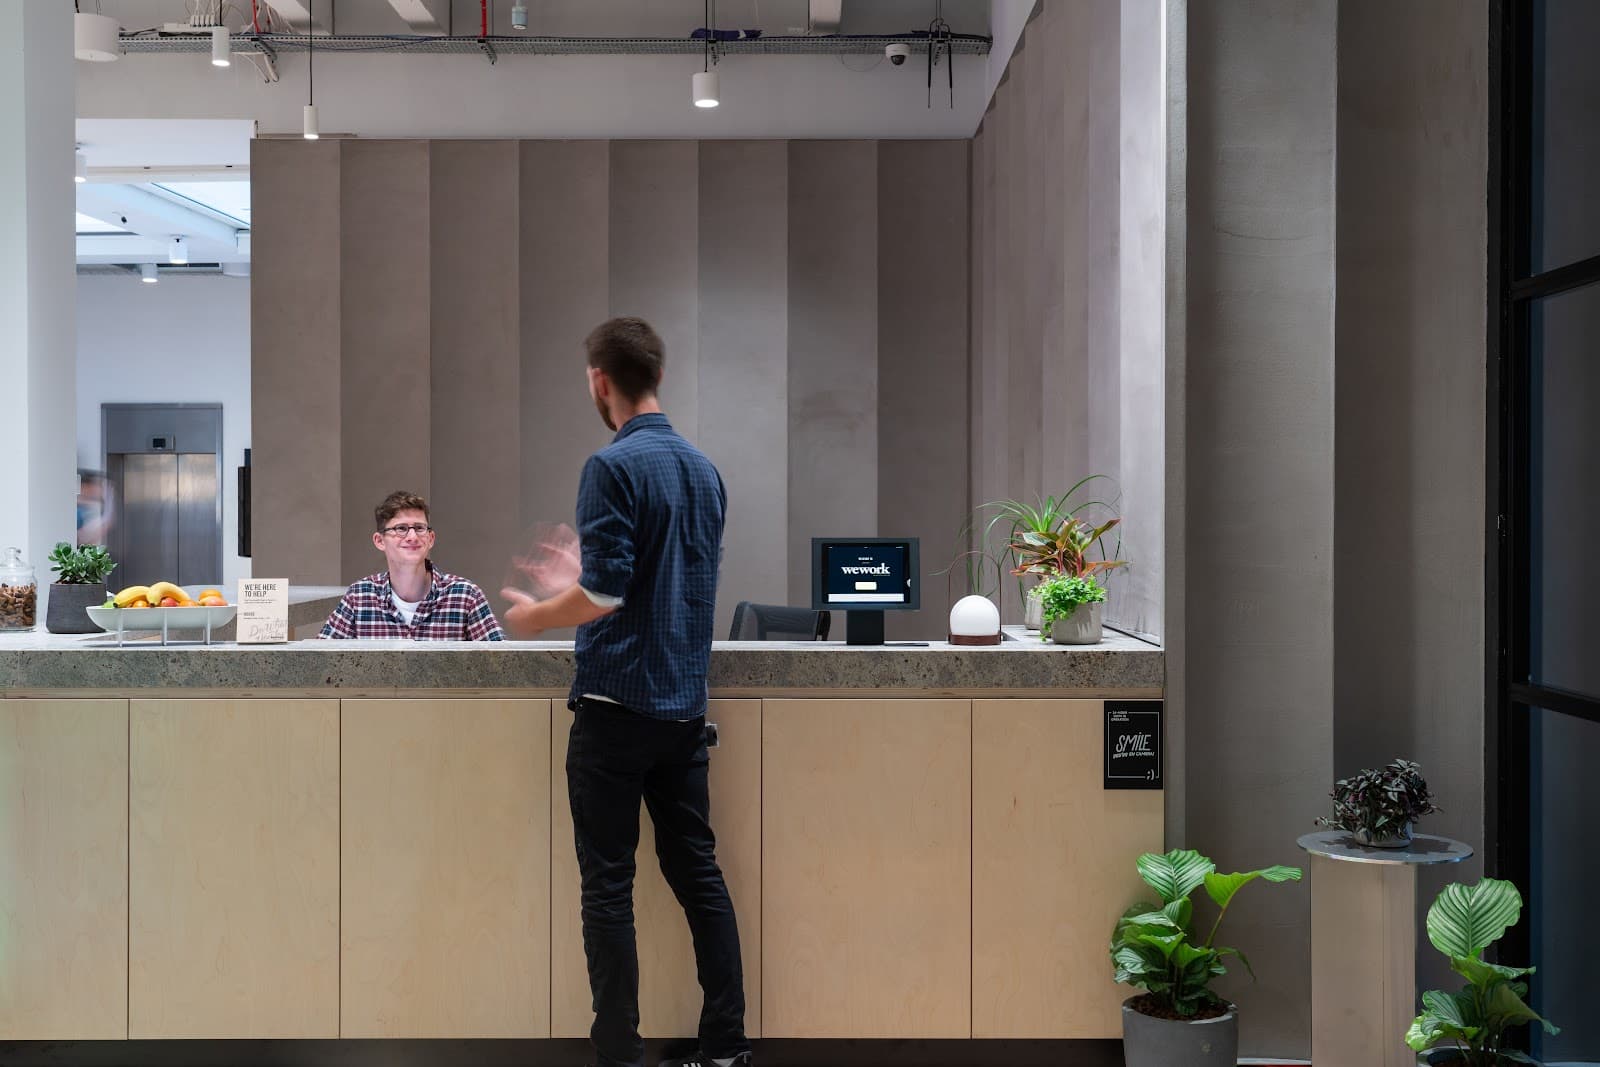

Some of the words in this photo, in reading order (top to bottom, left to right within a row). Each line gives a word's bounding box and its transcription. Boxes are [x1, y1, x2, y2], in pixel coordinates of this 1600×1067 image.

[841, 562, 891, 575] wework
[244, 583, 262, 591] WE'RE
[262, 583, 277, 591] HERE
[244, 590, 252, 598] TO
[253, 590, 267, 598] HELP
